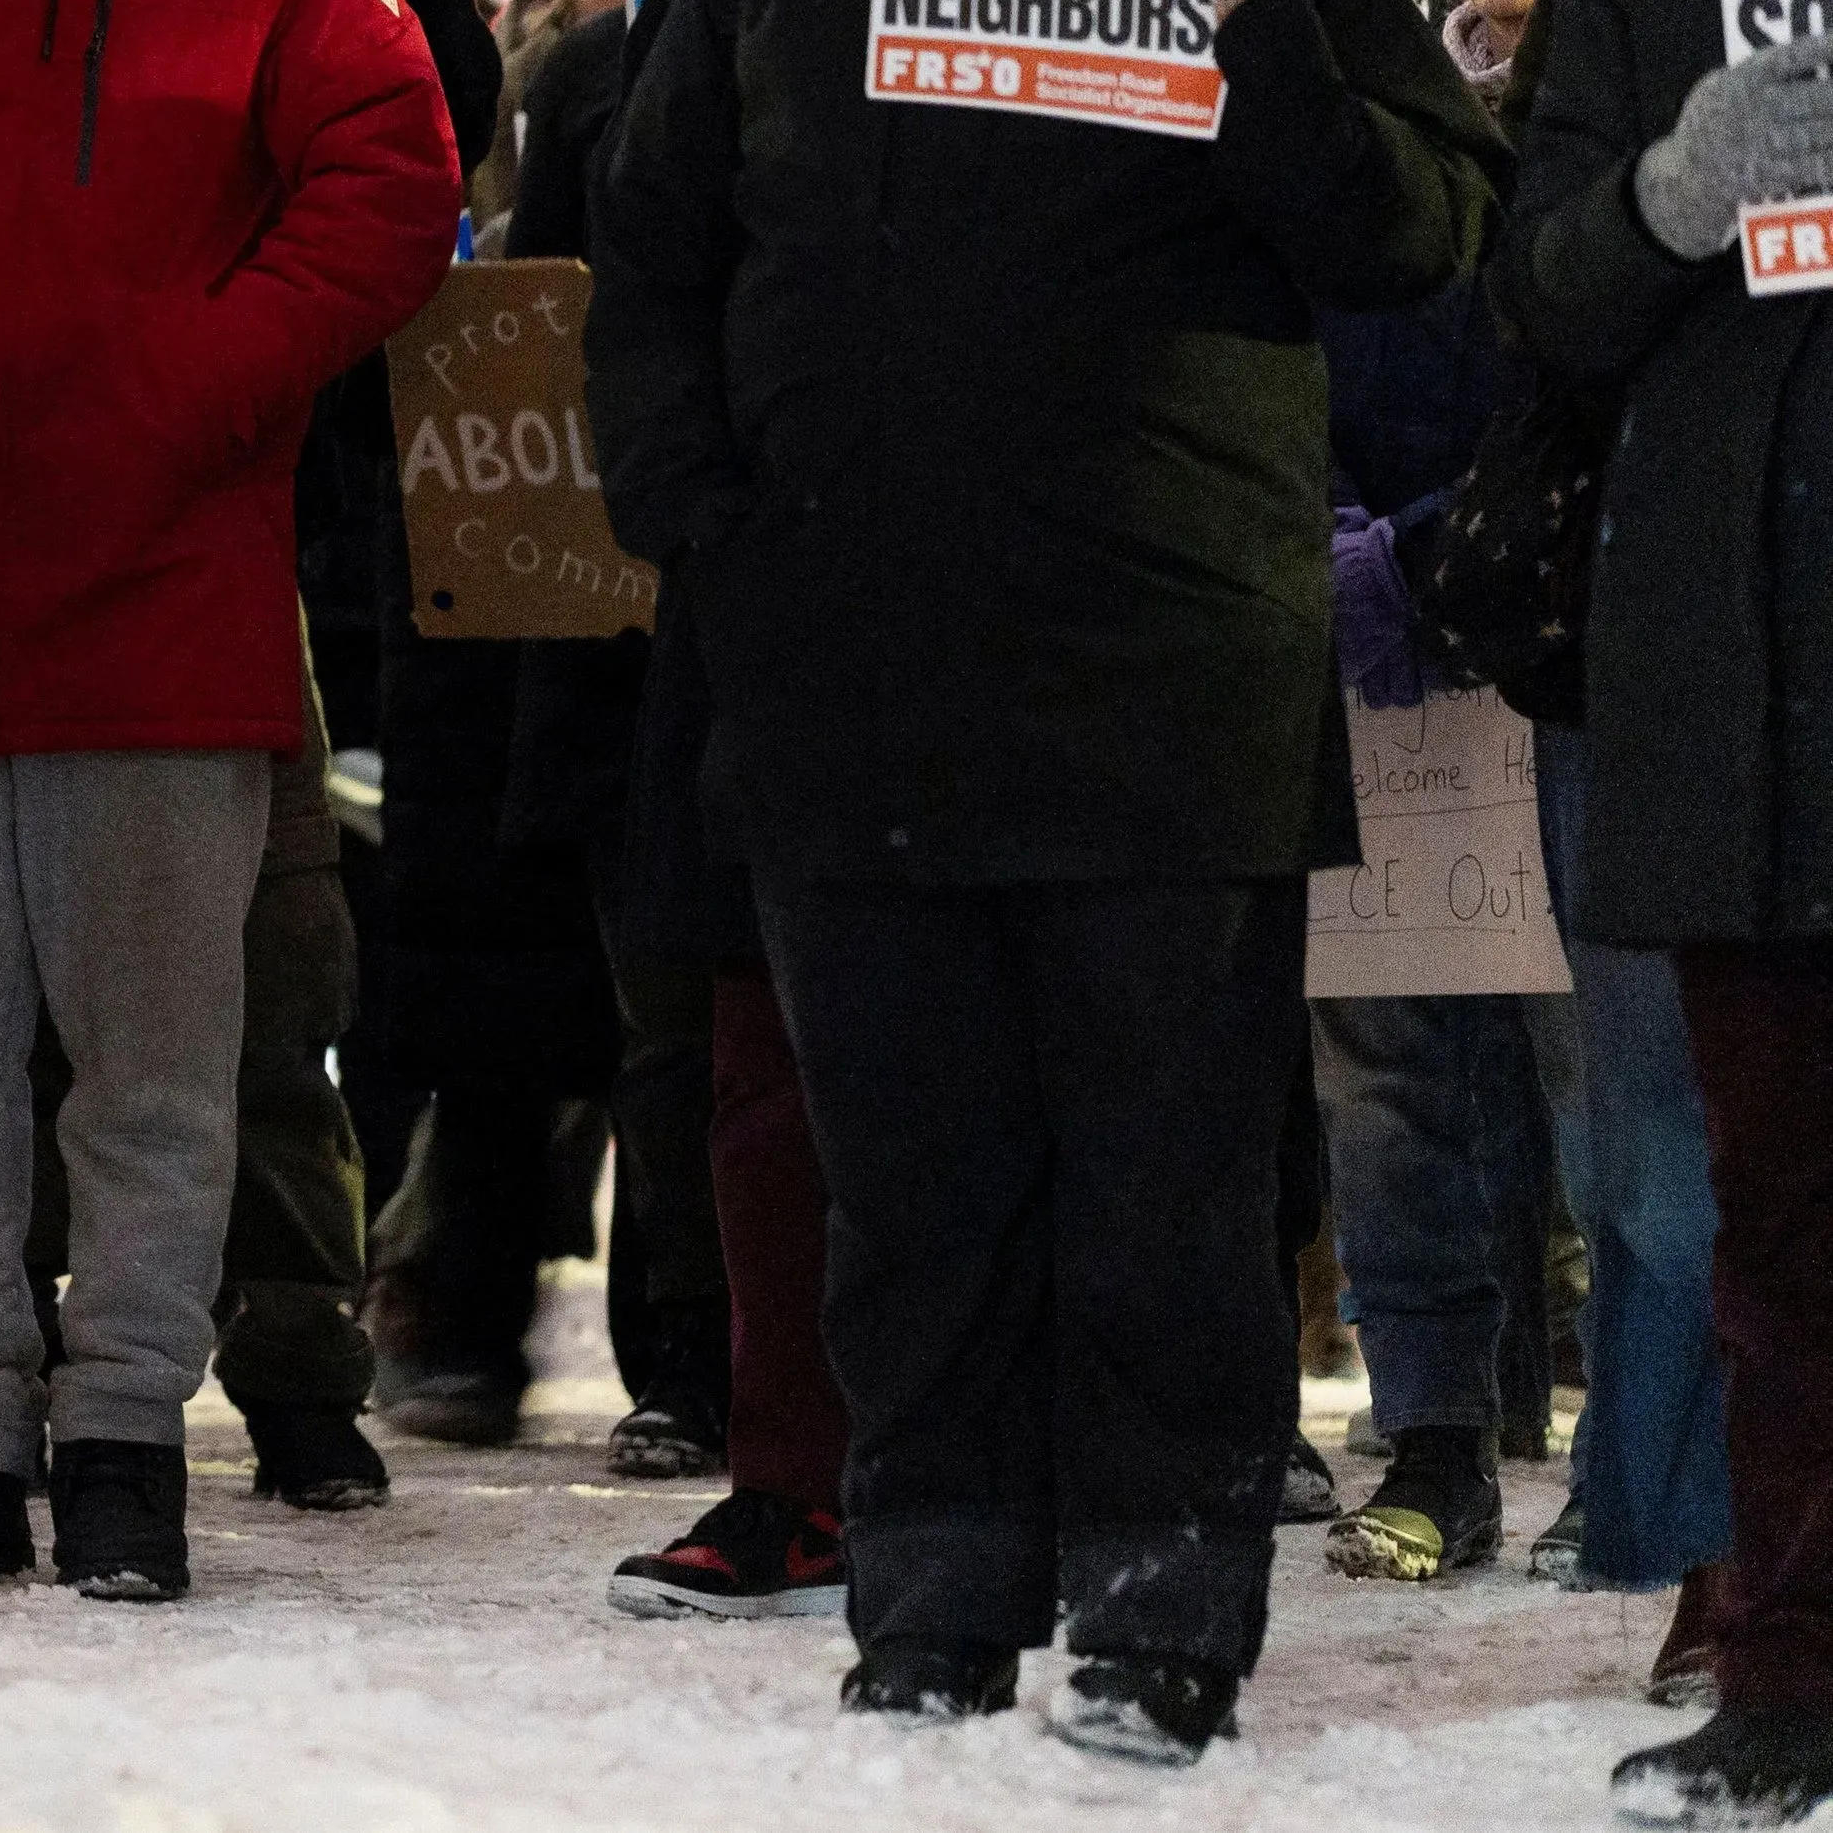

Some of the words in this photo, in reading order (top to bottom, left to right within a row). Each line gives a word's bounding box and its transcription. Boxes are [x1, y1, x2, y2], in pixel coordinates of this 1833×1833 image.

[1756, 222, 1833, 270] FR
[425, 295, 570, 395] Prot
[402, 407, 605, 494] ABOL
[455, 519, 659, 605] Comm
[1353, 750, 1471, 799] elcome
[1309, 858, 1400, 922] CE
